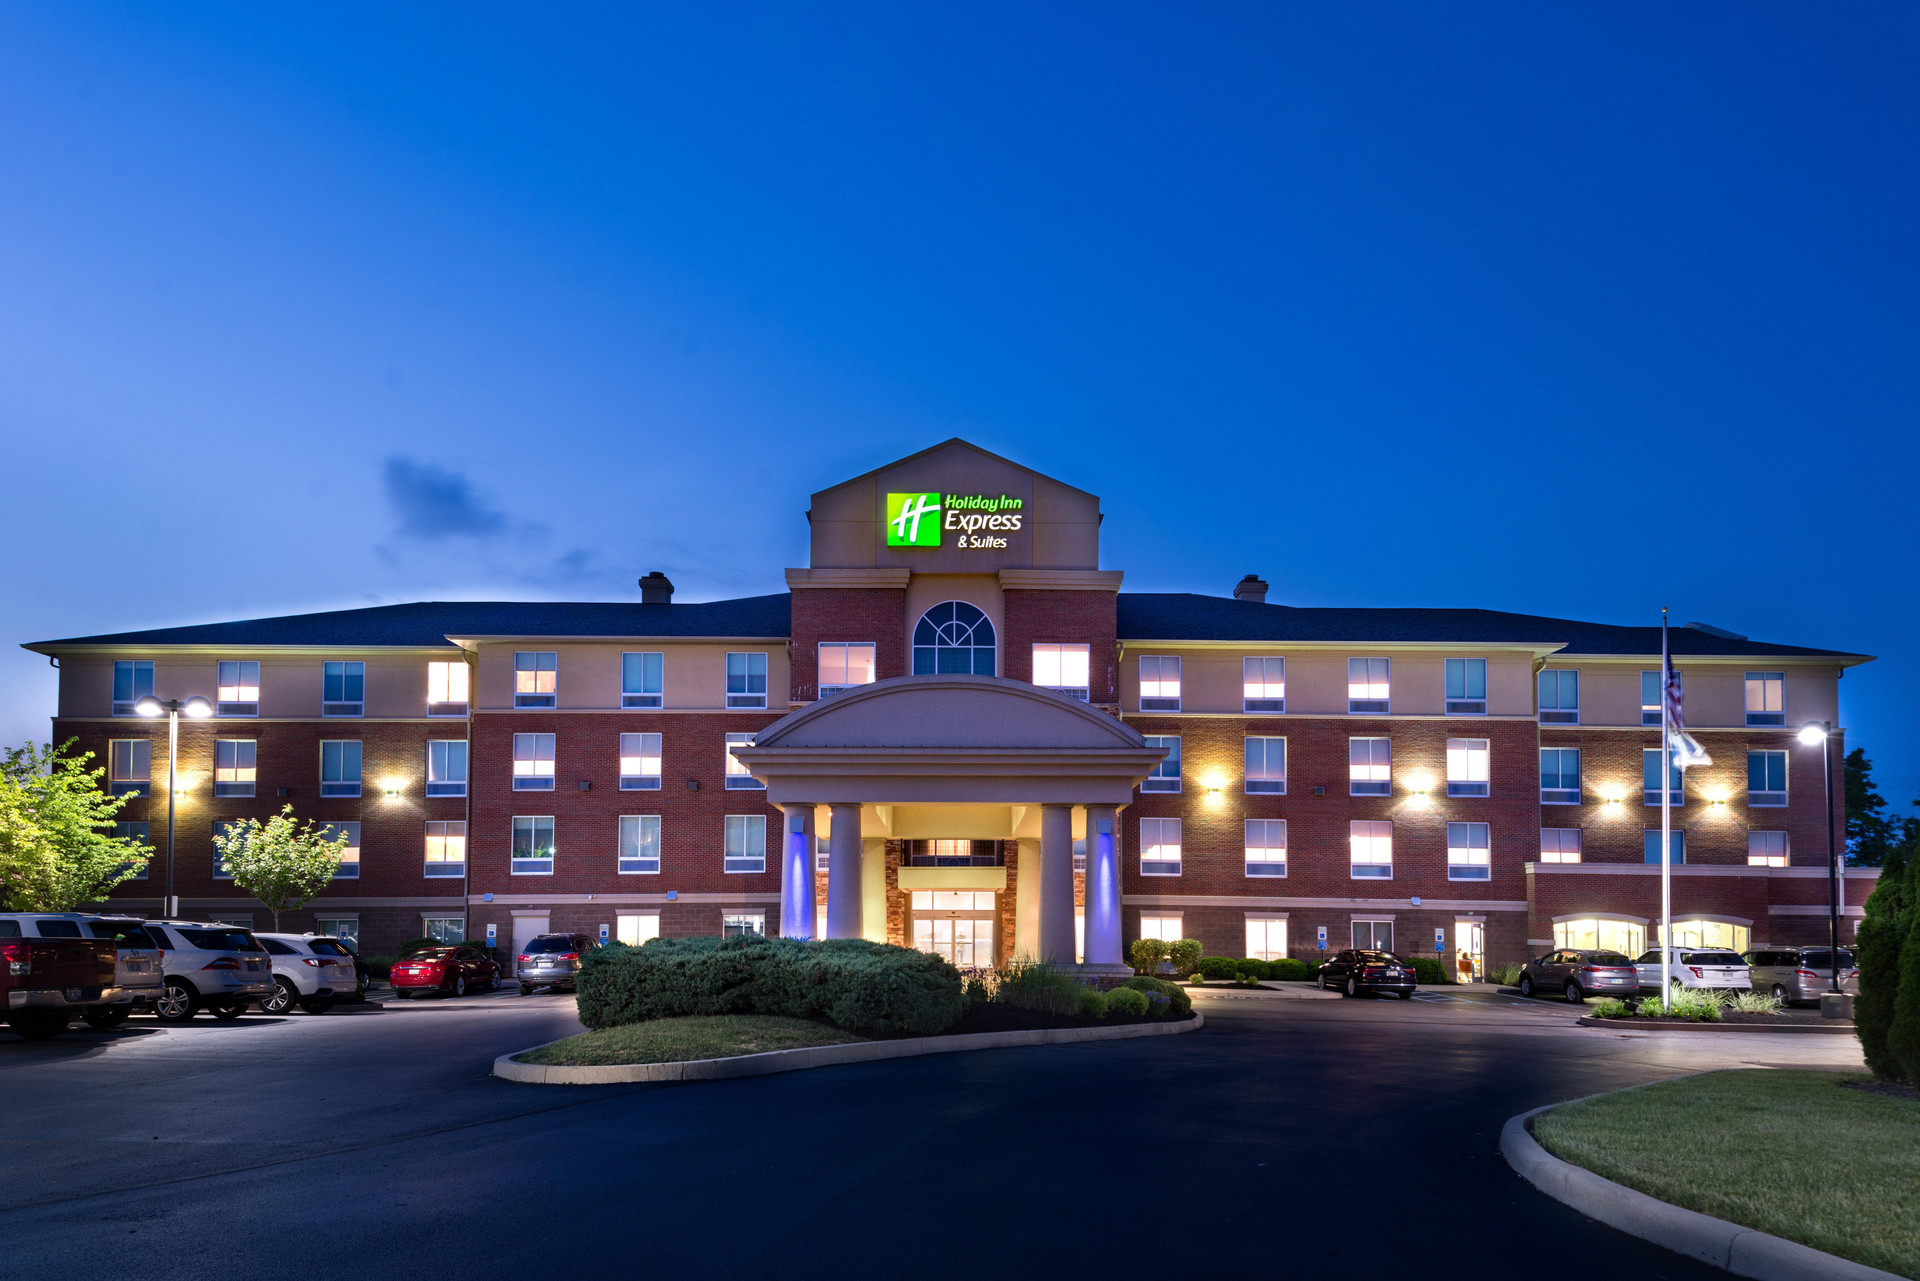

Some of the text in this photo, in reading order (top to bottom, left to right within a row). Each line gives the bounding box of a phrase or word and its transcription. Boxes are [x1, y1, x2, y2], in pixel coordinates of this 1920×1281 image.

[945, 494, 1022, 512] Holiday Inn
[944, 510, 1022, 535] Express
[958, 535, 1007, 548] & Suites
